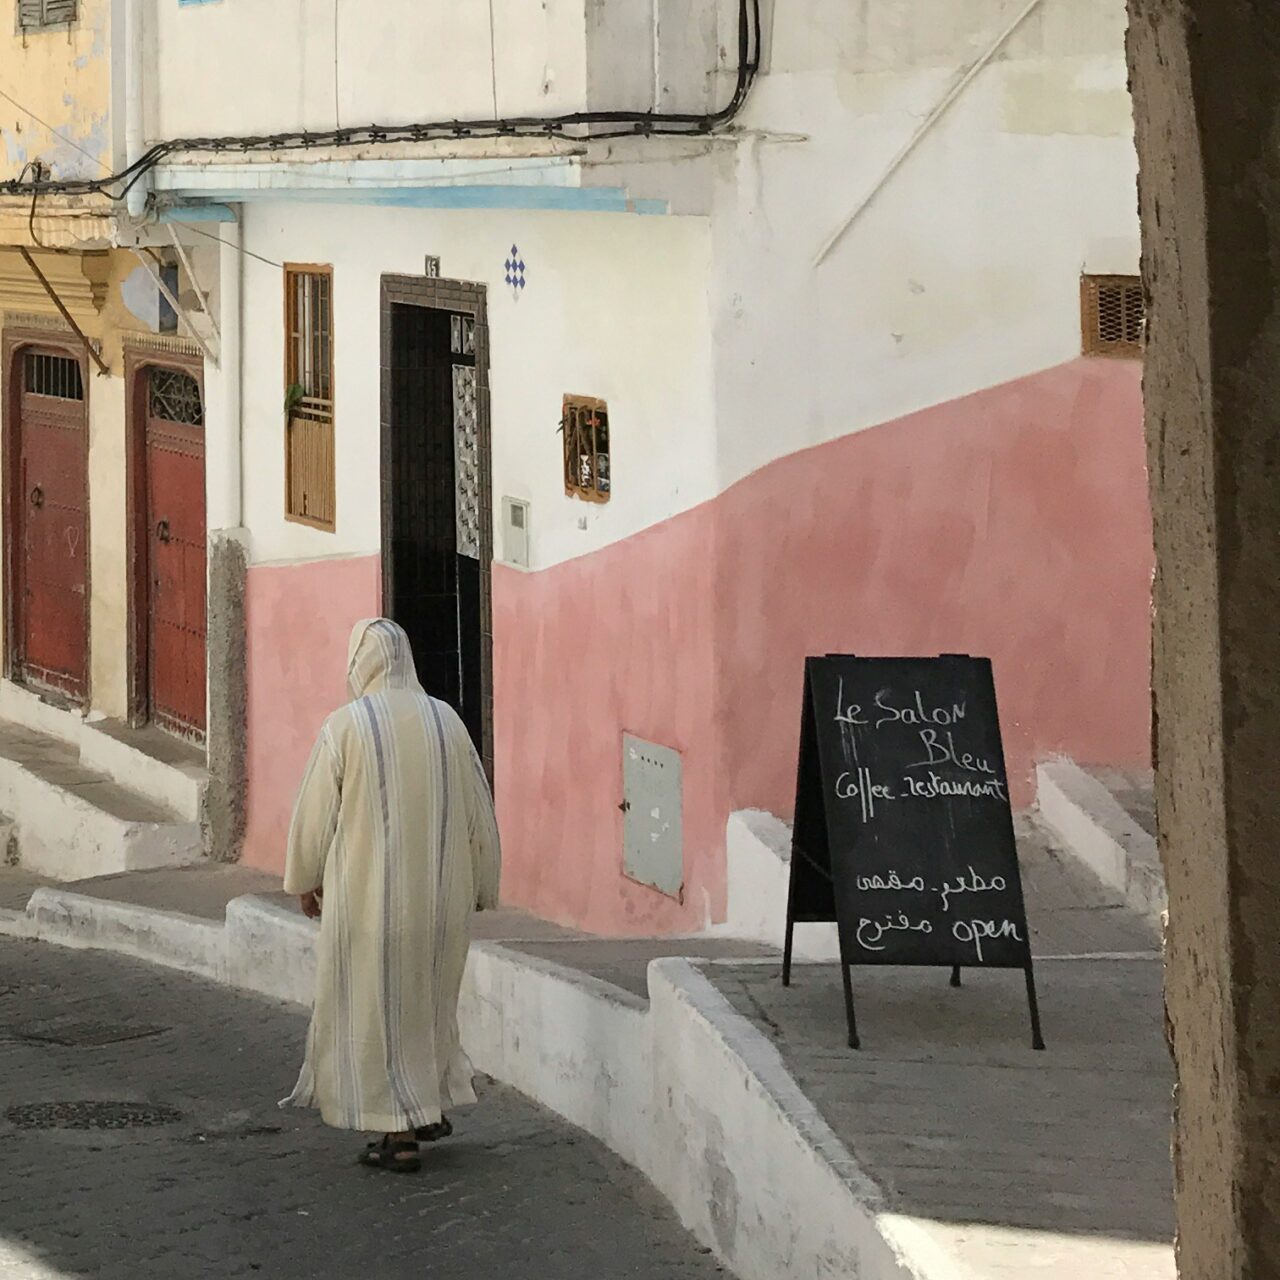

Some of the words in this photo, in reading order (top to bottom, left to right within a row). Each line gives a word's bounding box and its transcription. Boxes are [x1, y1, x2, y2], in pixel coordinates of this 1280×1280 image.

[833, 675, 869, 724] Le
[906, 728, 996, 774] Bleu
[940, 864, 1007, 912] مطعم
[855, 909, 933, 951] مفتوح
[952, 918, 1023, 962] open
